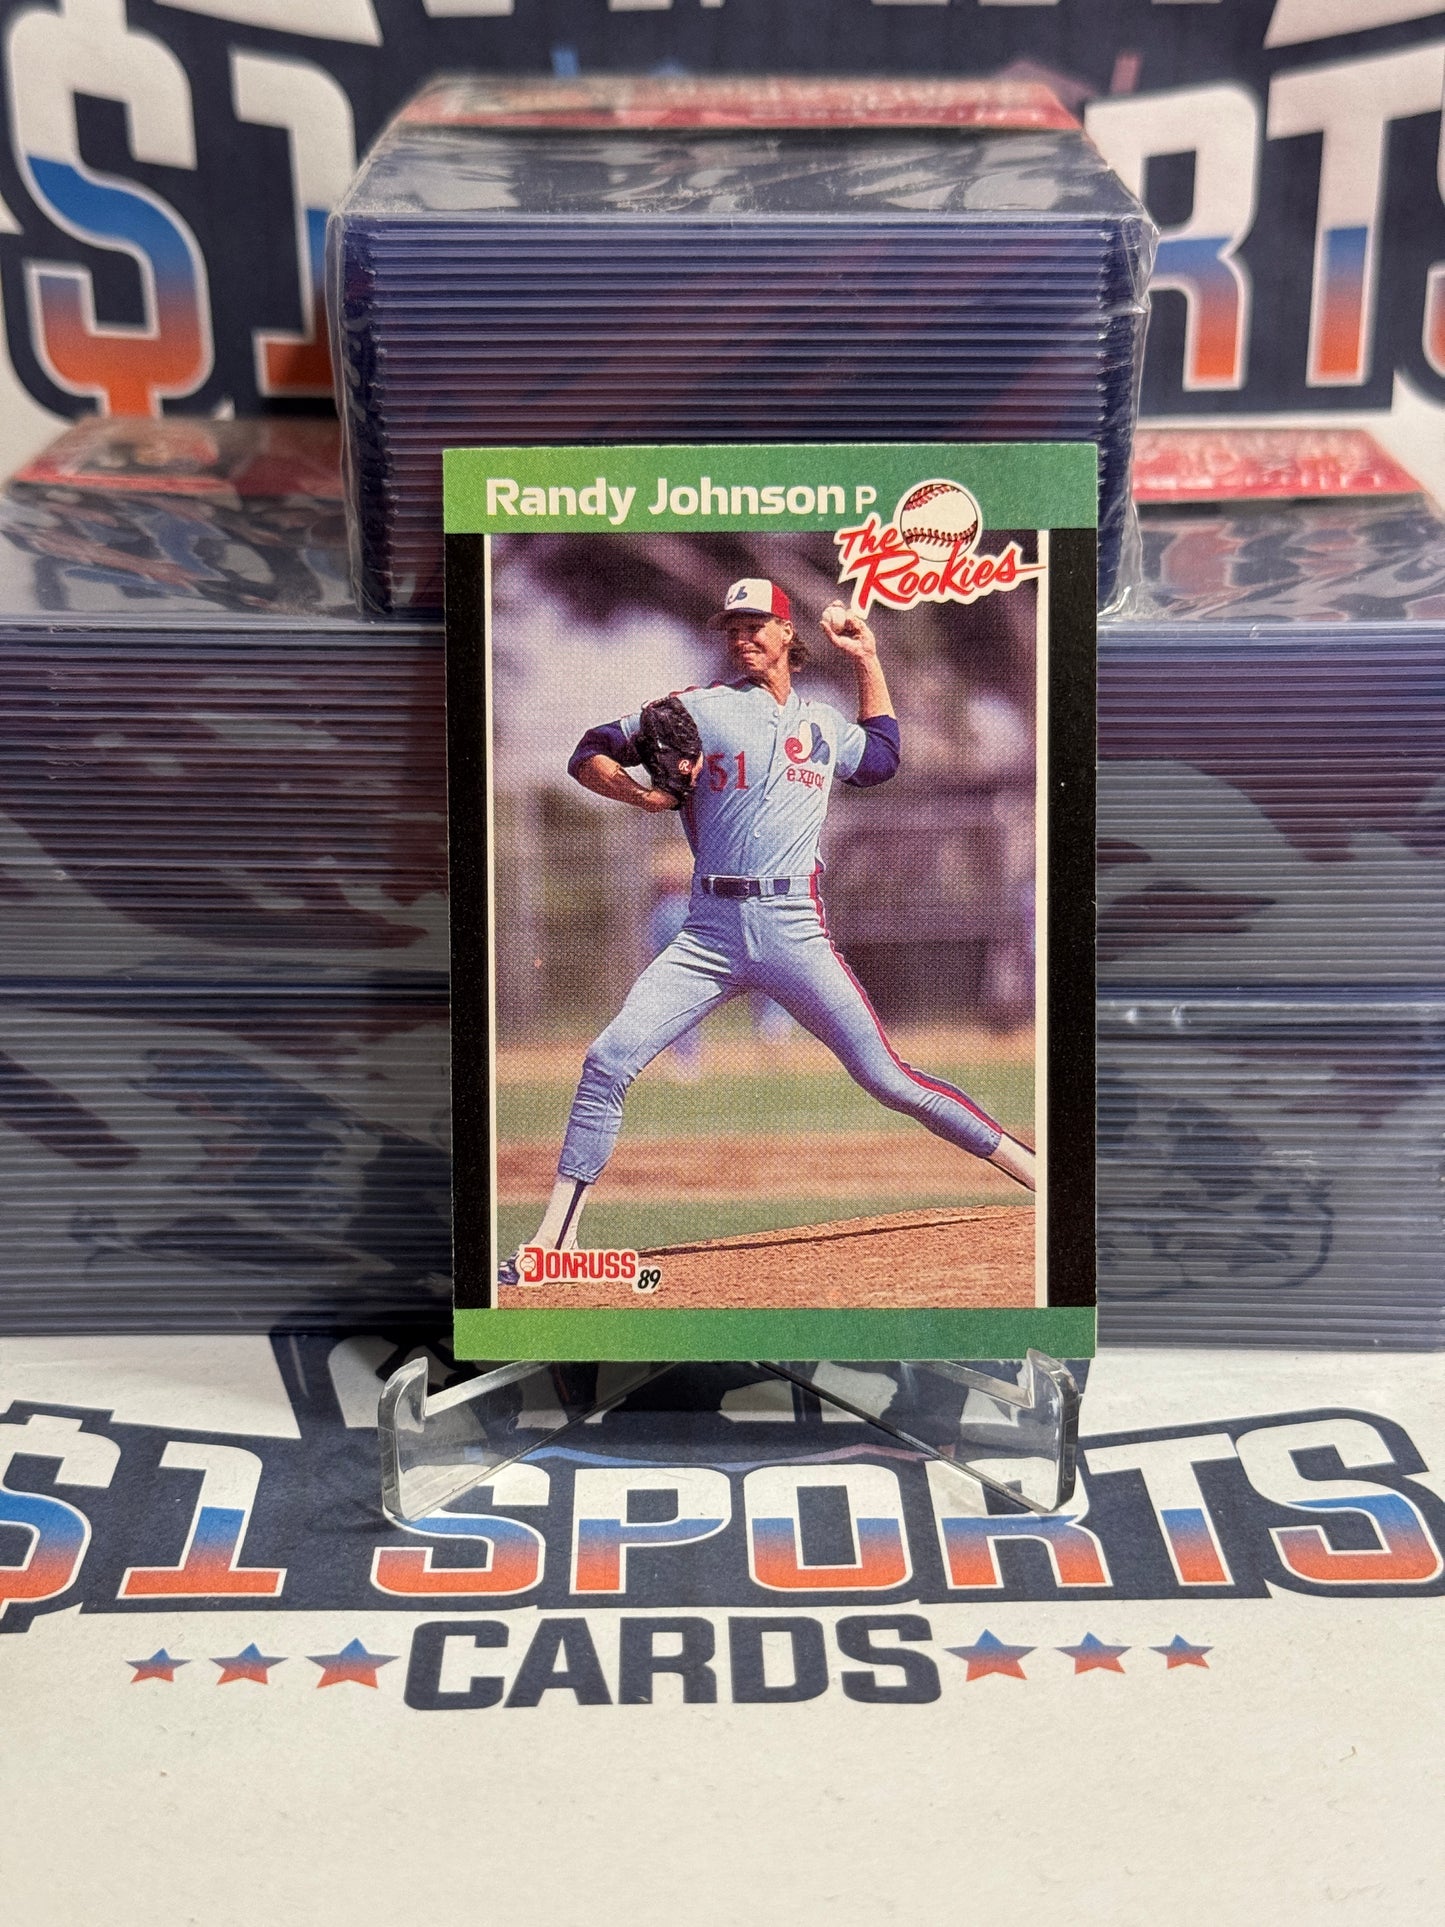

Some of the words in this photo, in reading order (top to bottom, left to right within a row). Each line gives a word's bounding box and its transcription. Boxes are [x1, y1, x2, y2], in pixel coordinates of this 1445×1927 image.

[486, 477, 636, 526] Randy
[648, 476, 845, 515] Johnson
[855, 486, 877, 514] P
[839, 518, 904, 561] The
[846, 539, 1047, 610] Rookies
[705, 750, 749, 792] 51
[519, 1247, 636, 1283] DONRUSS
[637, 1268, 661, 1290] 89
[370, 1417, 1445, 1597] SPORTS
[403, 1613, 942, 1712] CARDS
